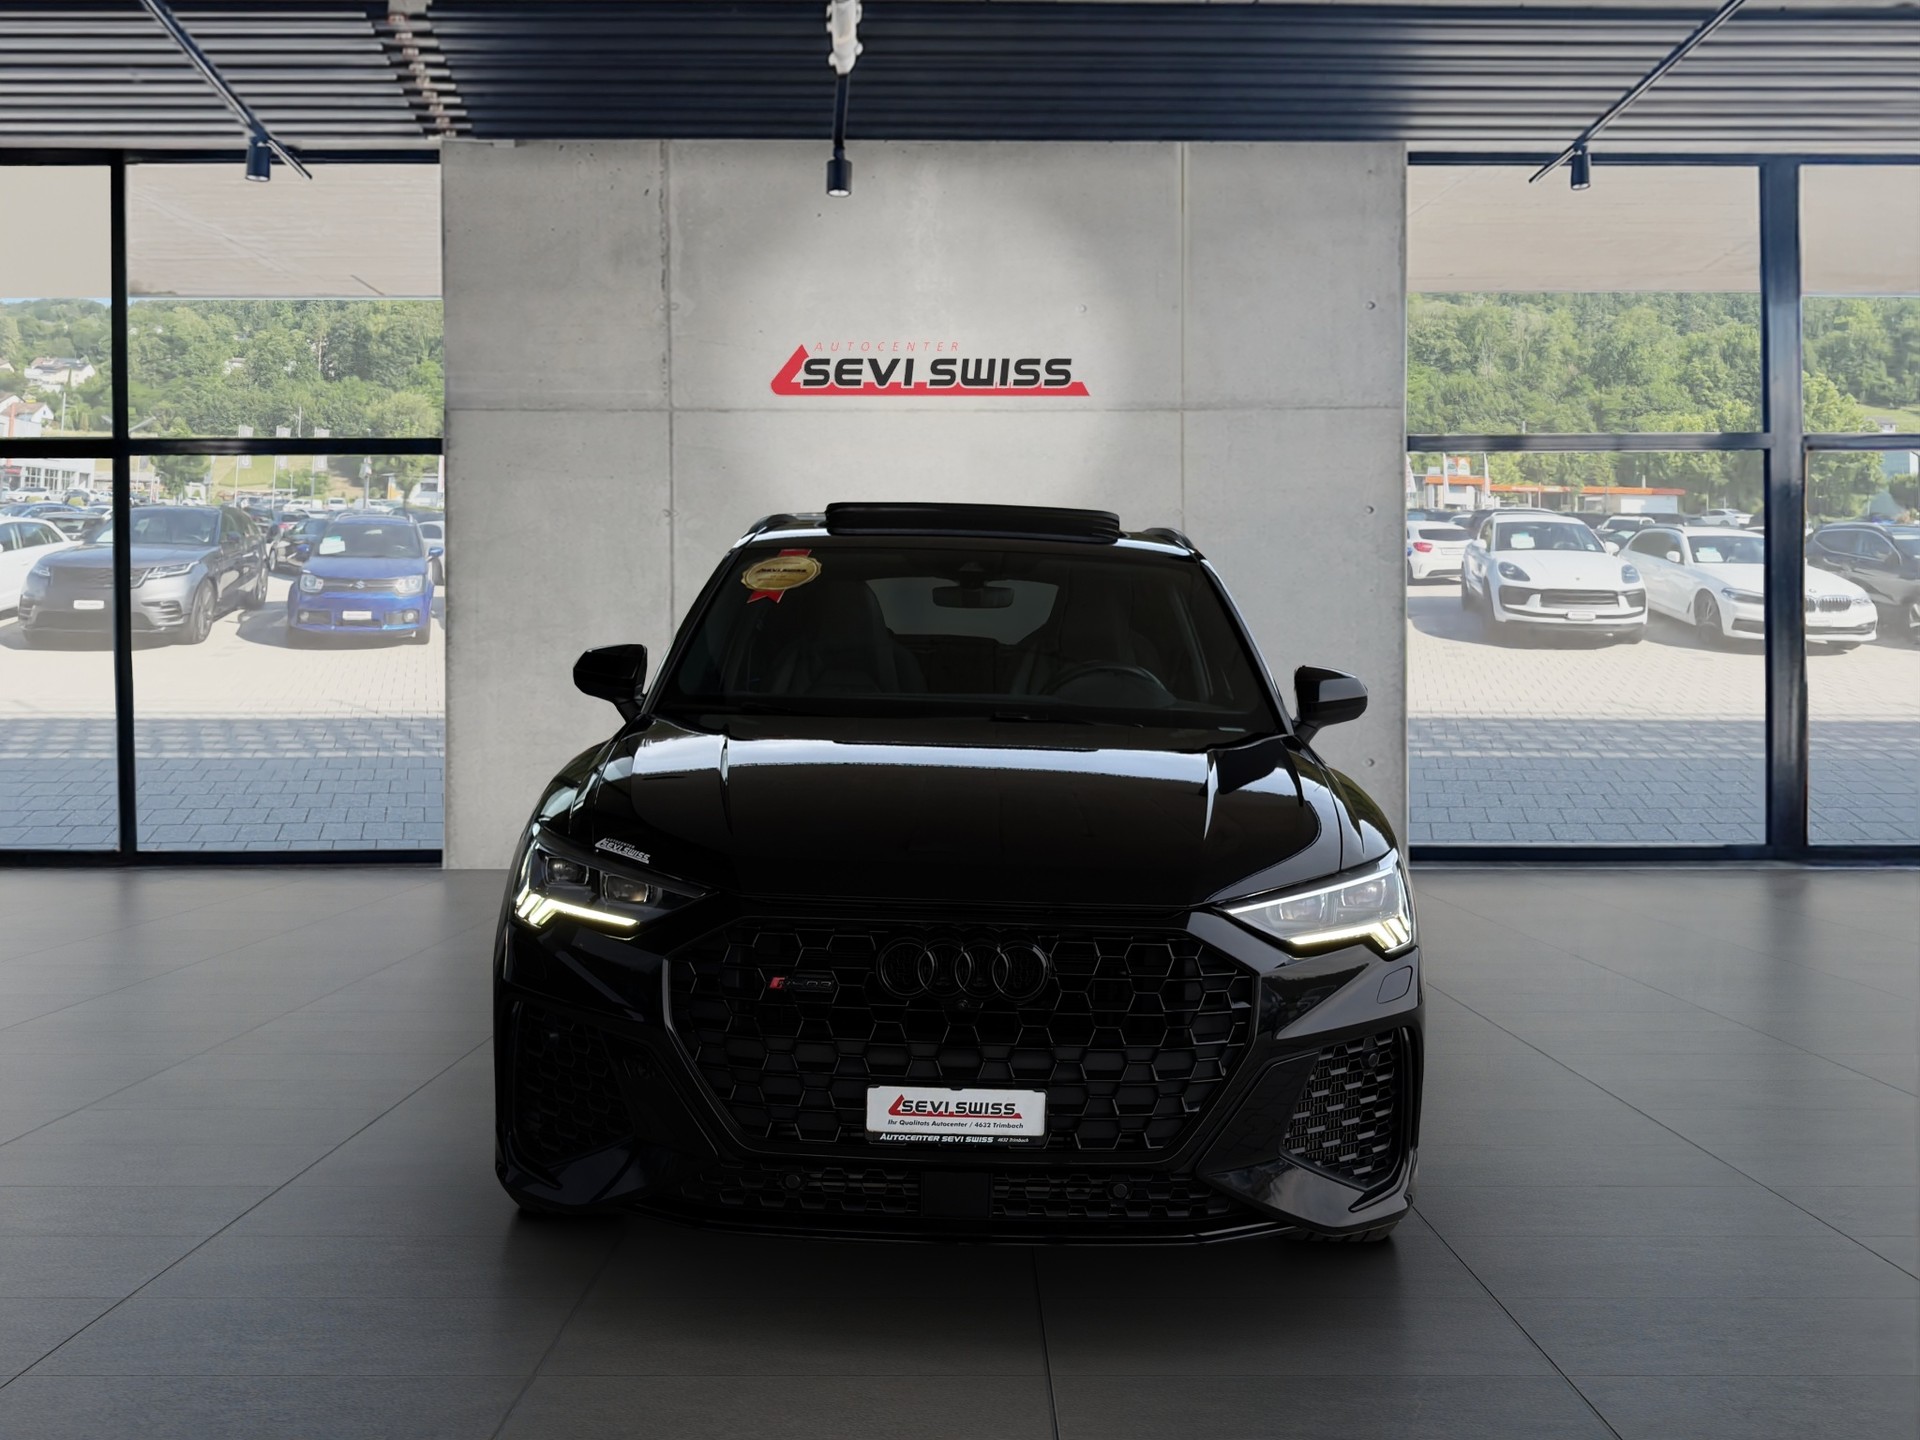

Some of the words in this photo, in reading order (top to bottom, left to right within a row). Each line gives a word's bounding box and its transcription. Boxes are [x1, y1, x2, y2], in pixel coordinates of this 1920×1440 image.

[814, 341, 960, 352] AUTOCENTER
[802, 358, 914, 387] SEVI
[928, 358, 1072, 387] SWISS
[600, 840, 623, 852] SEVI
[623, 847, 651, 861] SWISS
[901, 1100, 949, 1114] SEVI
[955, 1102, 1015, 1115] SWISS
[931, 1120, 968, 1128] Autocenter
